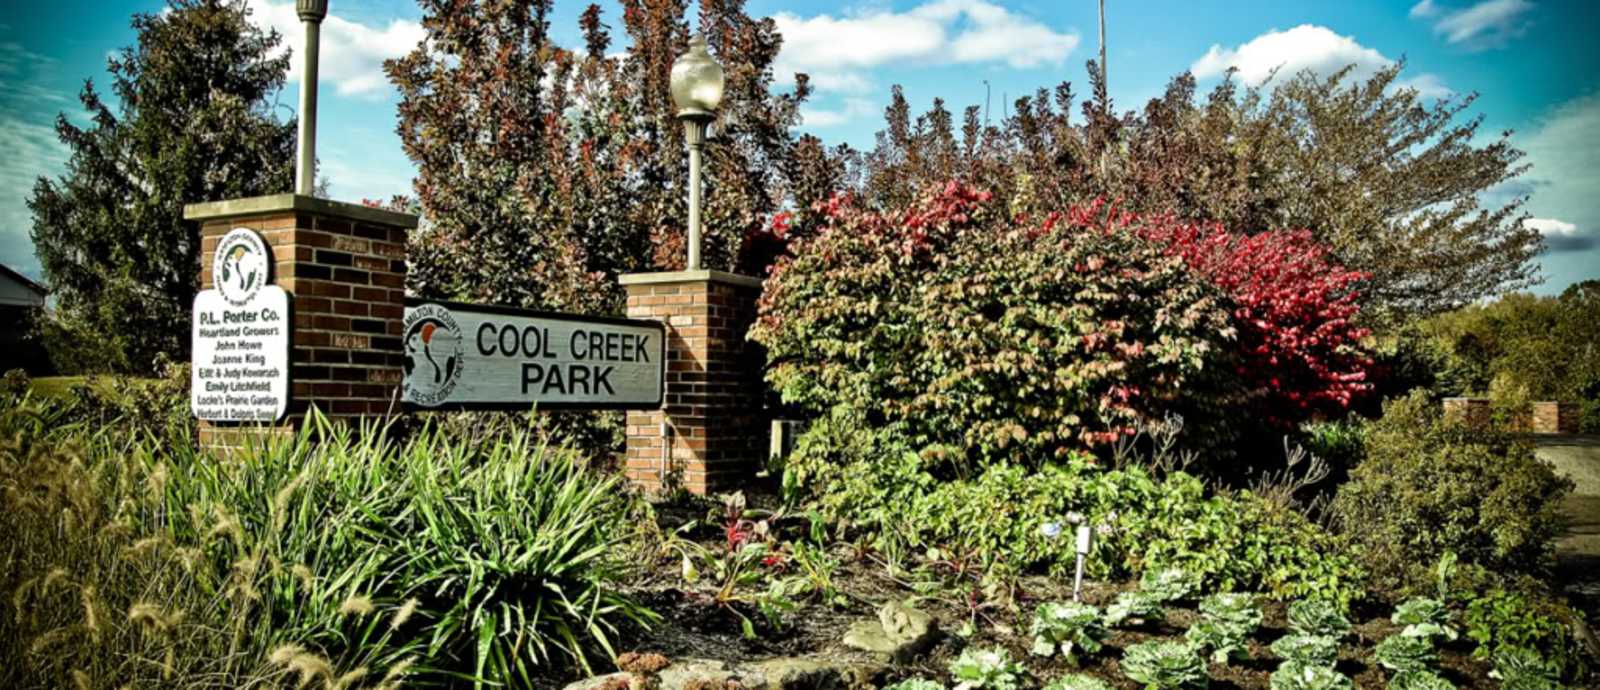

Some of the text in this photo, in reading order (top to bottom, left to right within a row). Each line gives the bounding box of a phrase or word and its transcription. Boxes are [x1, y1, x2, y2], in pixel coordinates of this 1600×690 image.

[200, 308, 280, 325] P.L. Porter Co.
[437, 307, 464, 341] COUNTY
[199, 326, 280, 338] Heartland Growers
[215, 340, 263, 351] John Howe
[477, 322, 649, 363] COOL CREEK
[212, 353, 266, 367] Joanne King
[223, 367, 241, 380] Judy
[521, 364, 615, 395] PARK
[205, 381, 271, 394] Emily Litchfield
[250, 394, 279, 406] Garden
